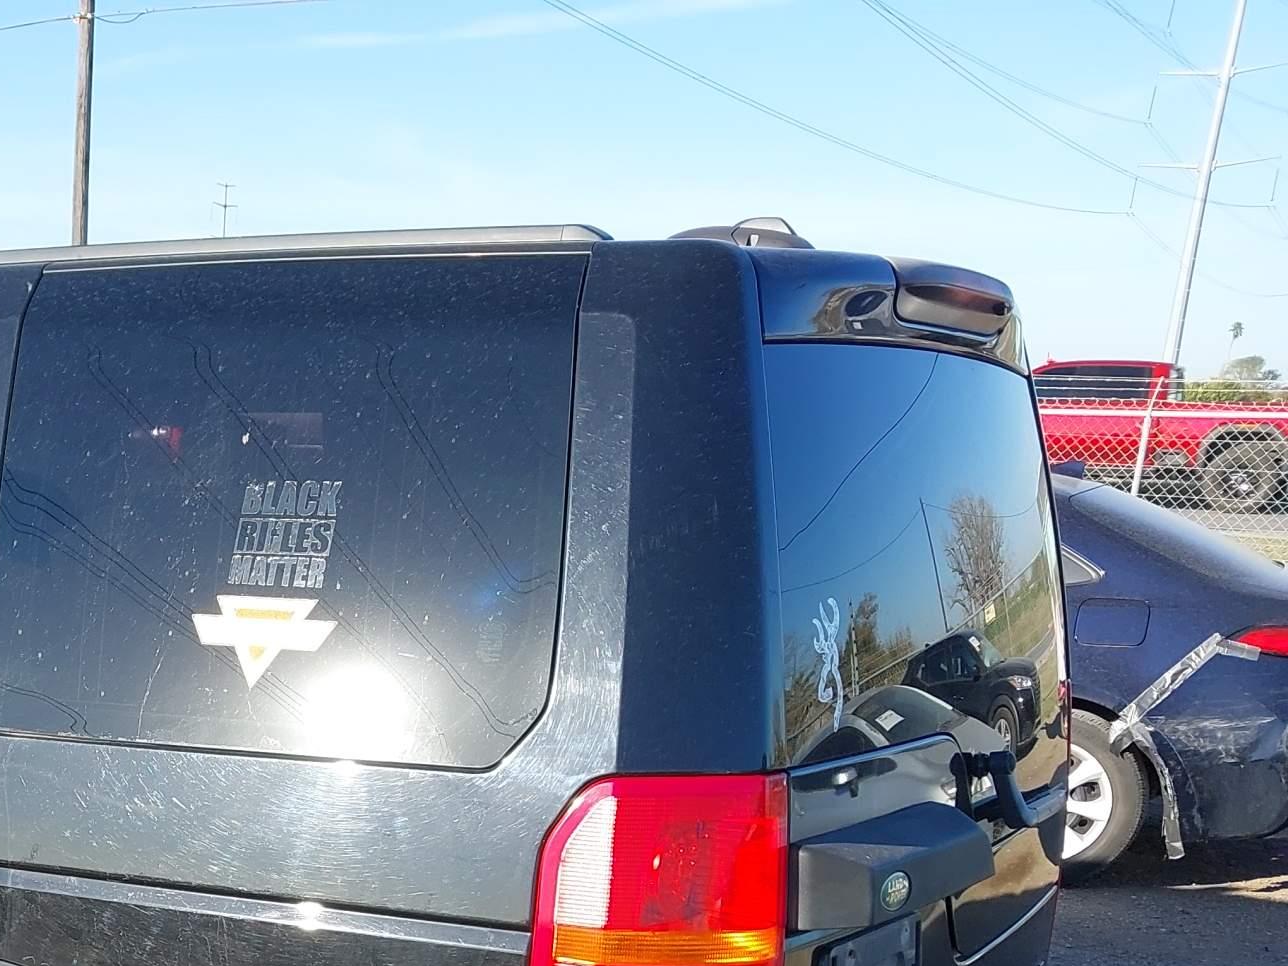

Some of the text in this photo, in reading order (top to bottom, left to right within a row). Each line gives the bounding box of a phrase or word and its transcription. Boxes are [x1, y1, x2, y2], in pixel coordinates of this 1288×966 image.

[241, 479, 343, 516] BLACK
[235, 520, 334, 555] RIFLES
[228, 555, 326, 588] MATTER
